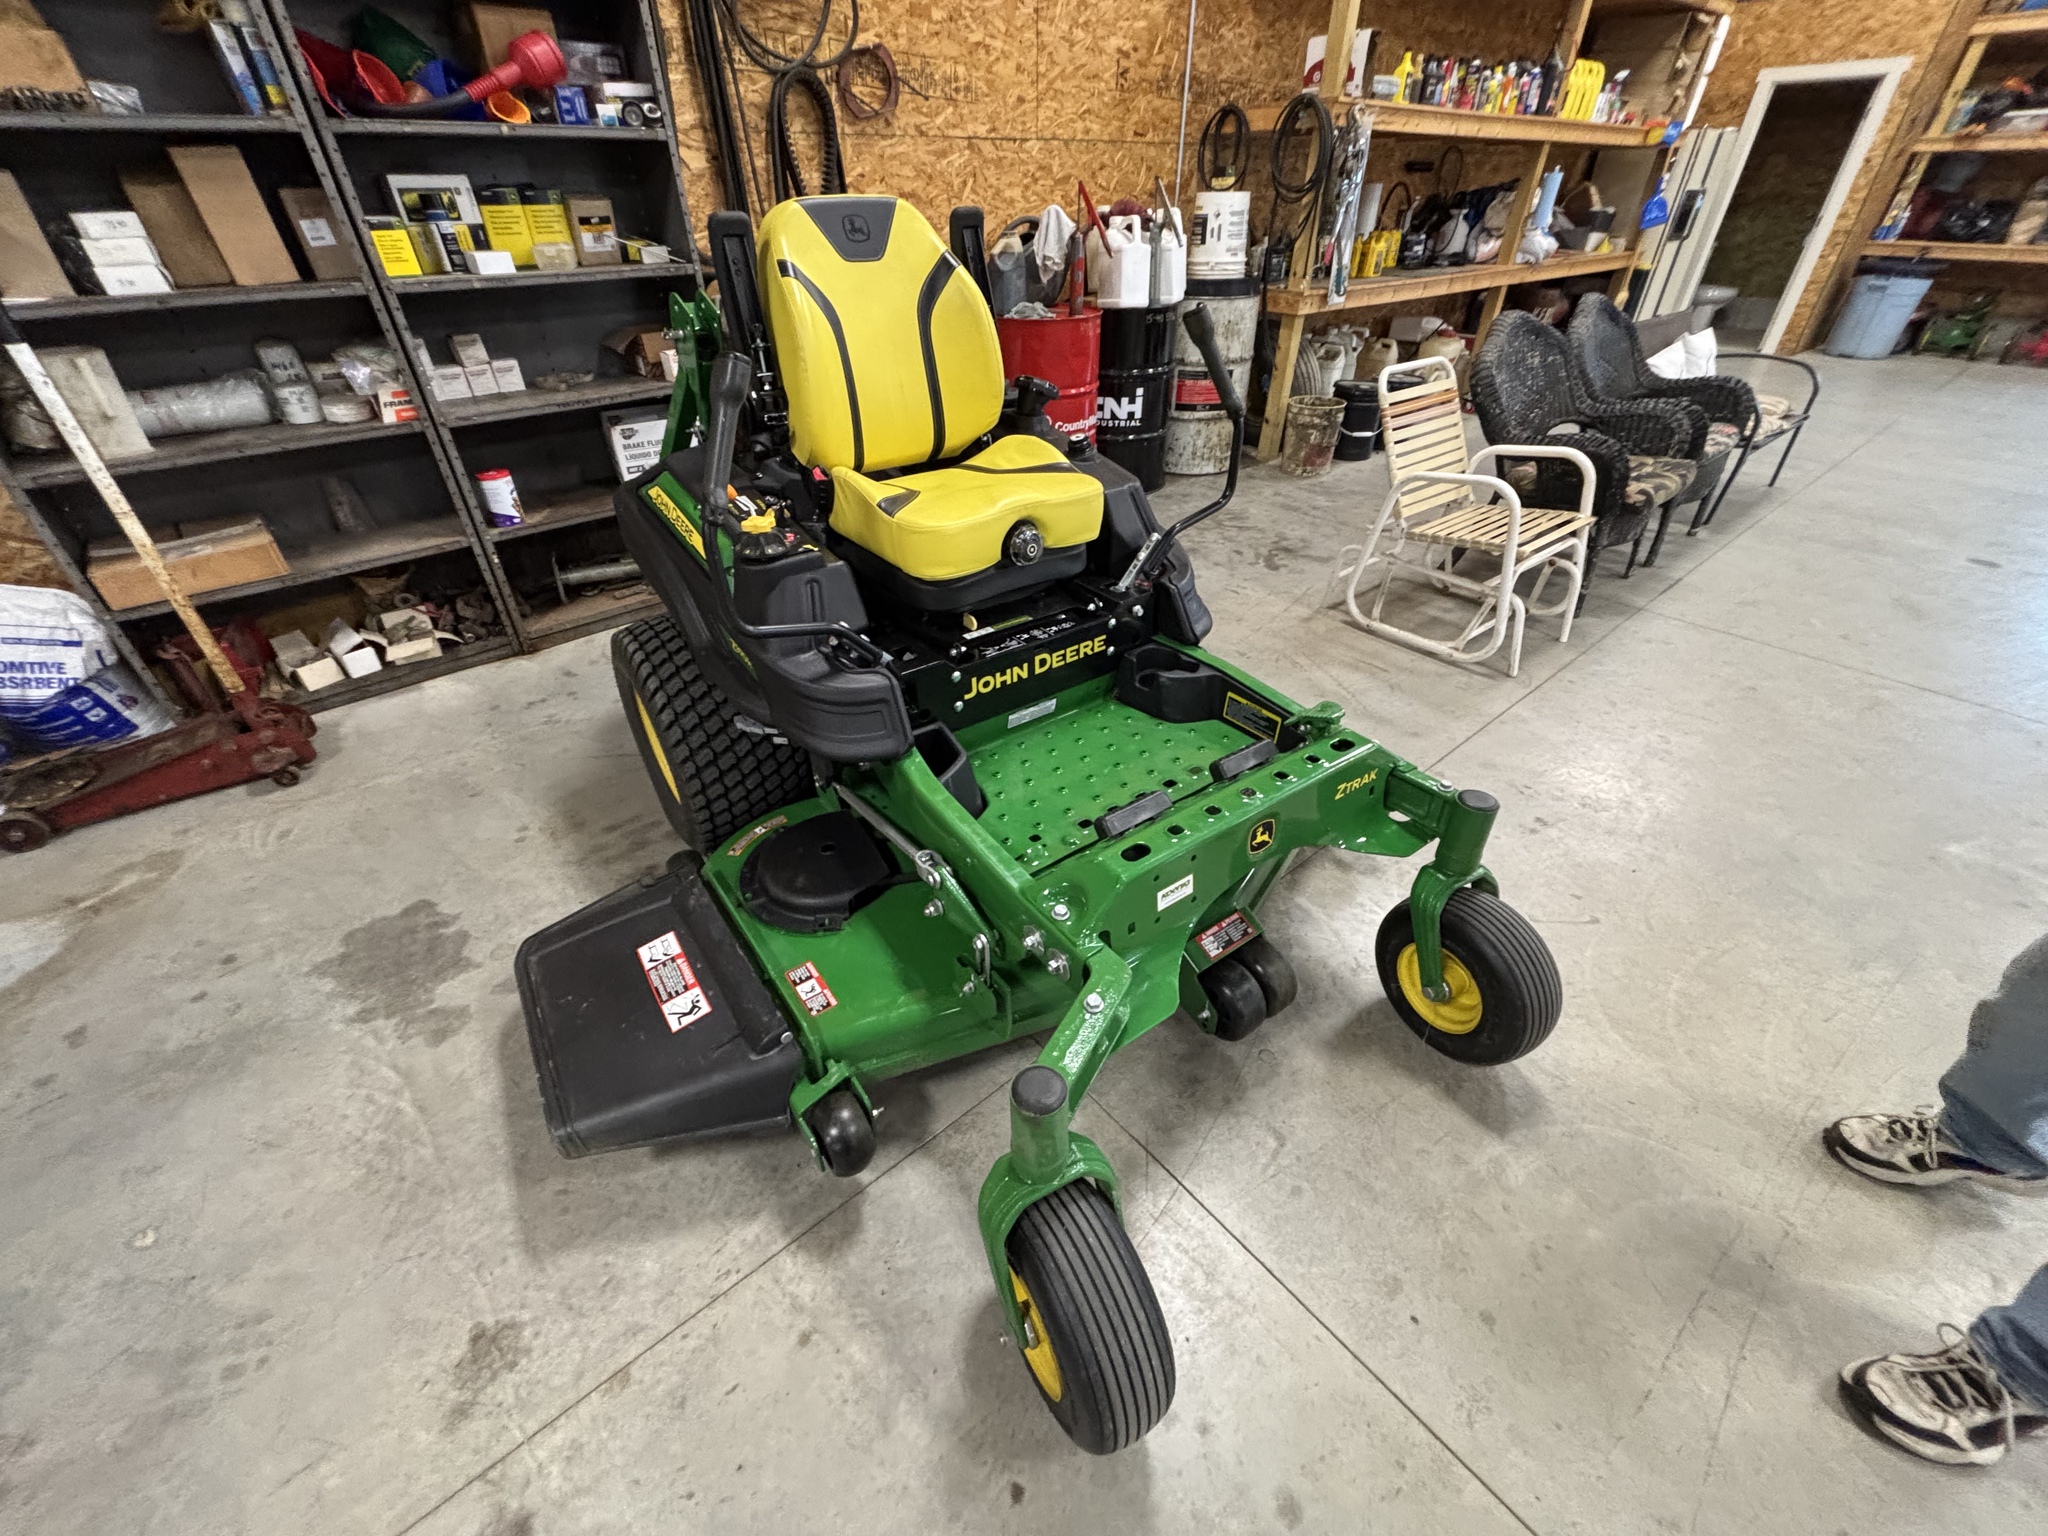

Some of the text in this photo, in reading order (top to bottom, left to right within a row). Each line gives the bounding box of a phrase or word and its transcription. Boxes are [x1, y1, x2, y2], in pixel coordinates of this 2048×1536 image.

[1096, 419, 1141, 428] DUSTRIAL
[622, 439, 663, 451] BRAKE FLU
[964, 635, 1107, 700] JOHN DEERE
[1334, 768, 1378, 801] ZTRAK
